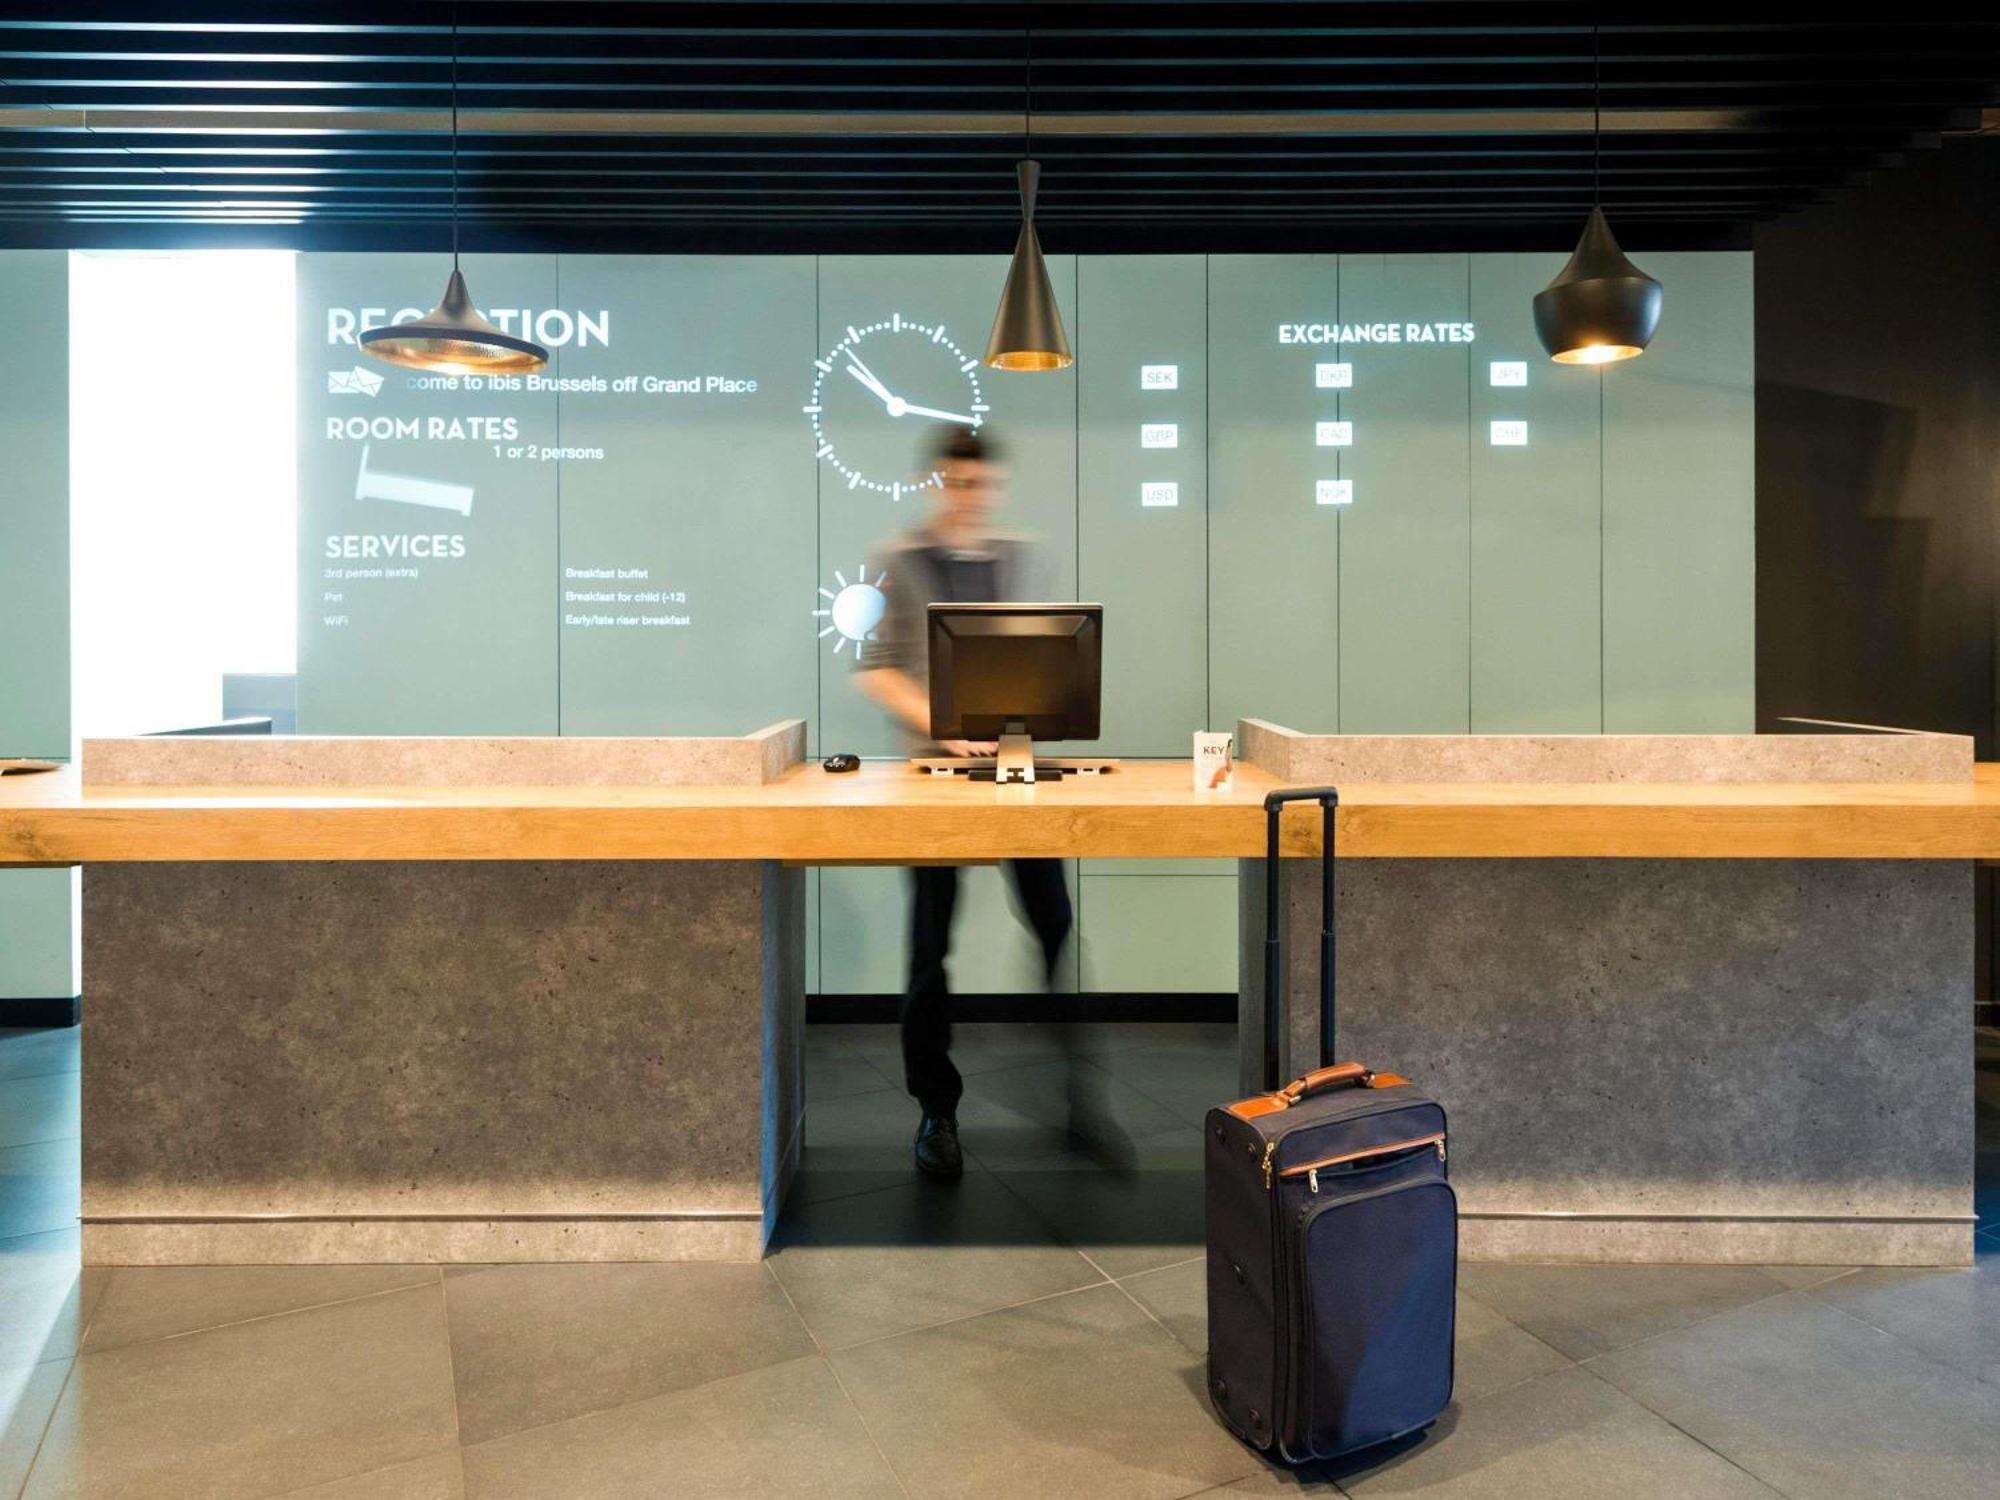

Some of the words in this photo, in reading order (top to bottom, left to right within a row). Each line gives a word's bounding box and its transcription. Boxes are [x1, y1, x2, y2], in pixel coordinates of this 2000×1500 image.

[326, 307, 610, 347] RETION
[1278, 323, 1401, 344] EXCHANGE
[1405, 322, 1476, 343] RATES
[1146, 371, 1173, 383] SEK
[462, 374, 483, 391] to
[526, 375, 607, 392] Brussels
[612, 376, 638, 393] off
[643, 376, 701, 393] Grand
[706, 377, 758, 393] Place
[326, 416, 419, 441] ROOM
[428, 417, 519, 440] RATES
[1145, 430, 1174, 442] GBP
[493, 444, 501, 458] 1
[507, 447, 523, 458] or
[527, 444, 537, 458] 2
[541, 445, 604, 461] persons
[1146, 488, 1174, 501] USD
[325, 535, 466, 559] SERVICES
[323, 568, 342, 578] 3rd
[345, 569, 382, 579] person
[385, 568, 418, 580] (extra)
[565, 567, 615, 579] Breakfast
[617, 568, 649, 579] buffet
[565, 591, 615, 602] Breakfast
[617, 592, 632, 602] for
[634, 592, 660, 602] child
[565, 614, 614, 626] Early/late
[616, 615, 640, 625] riser
[641, 615, 691, 626] breakfast
[1203, 746, 1225, 755] KEY
